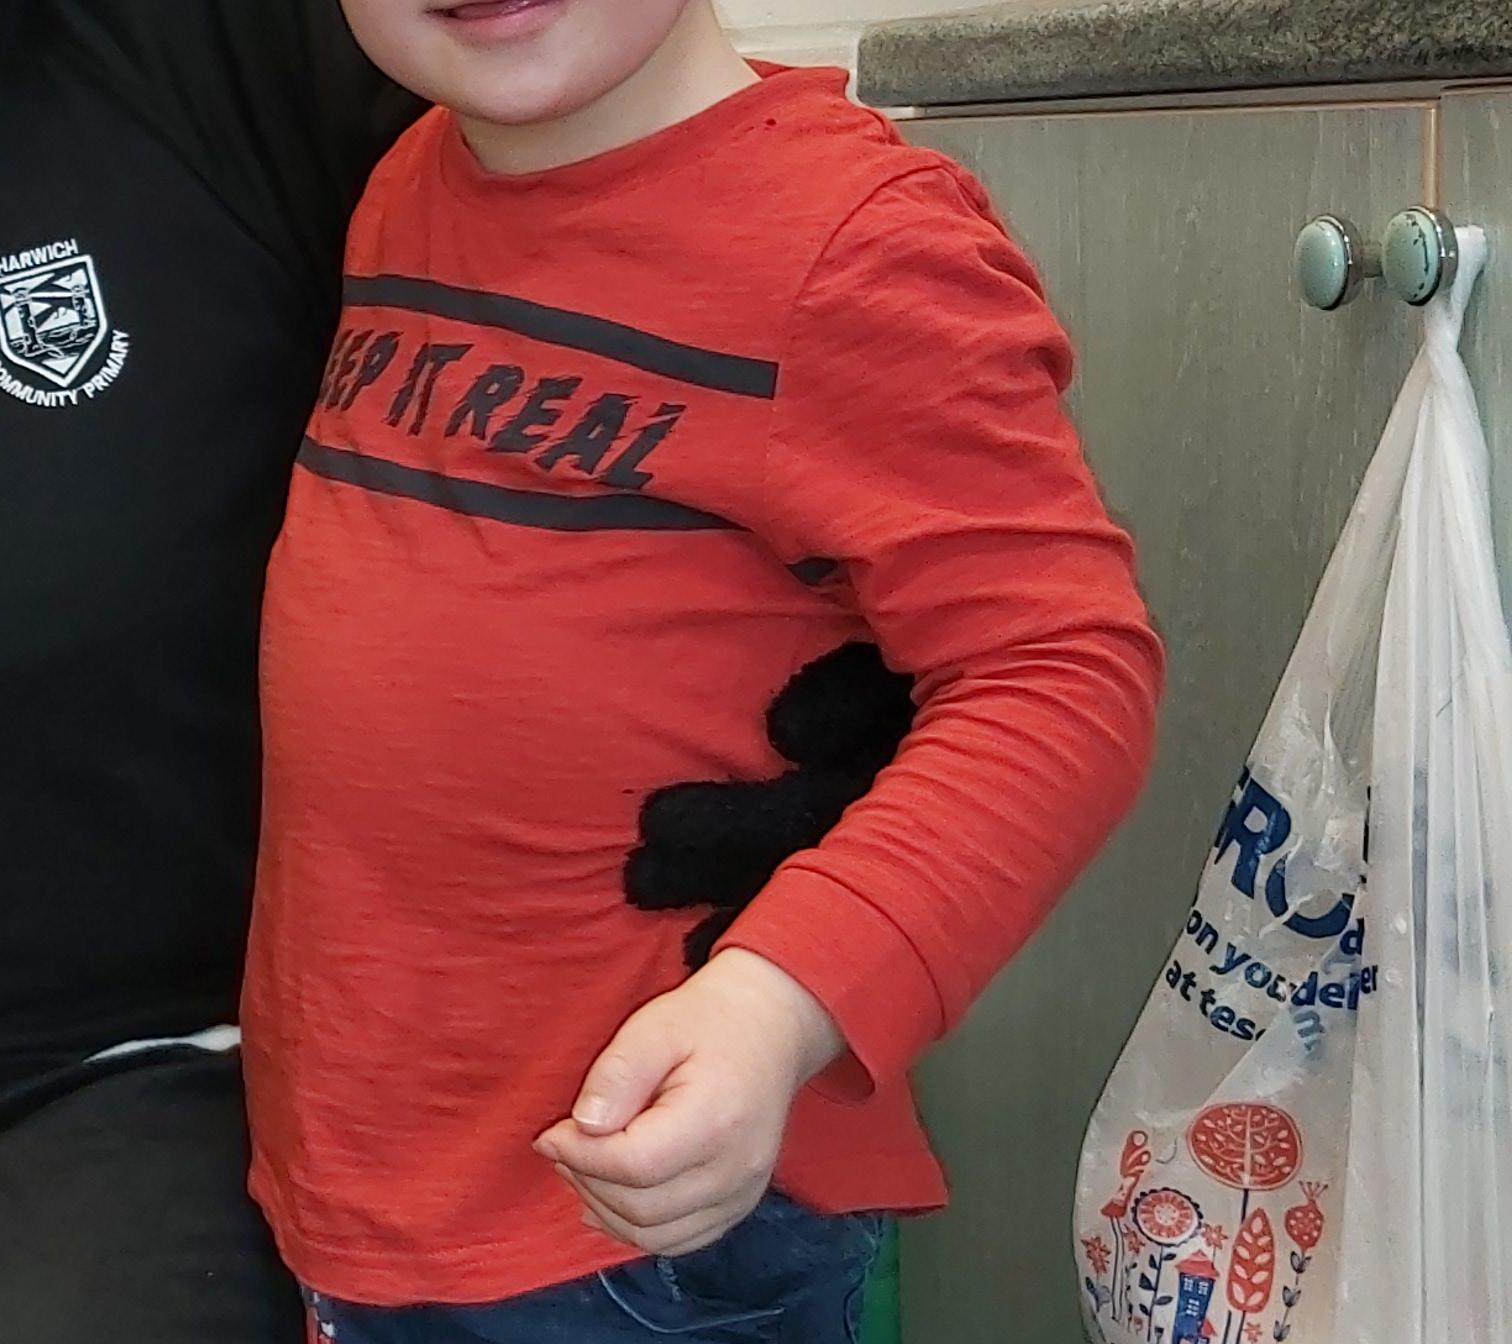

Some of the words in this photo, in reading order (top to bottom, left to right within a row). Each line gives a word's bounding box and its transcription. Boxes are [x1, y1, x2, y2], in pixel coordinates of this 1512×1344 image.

[82, 329, 130, 398] PRIMARY
[382, 342, 475, 436] IT
[444, 364, 685, 490] REAL
[1199, 988, 1267, 1042] tes
